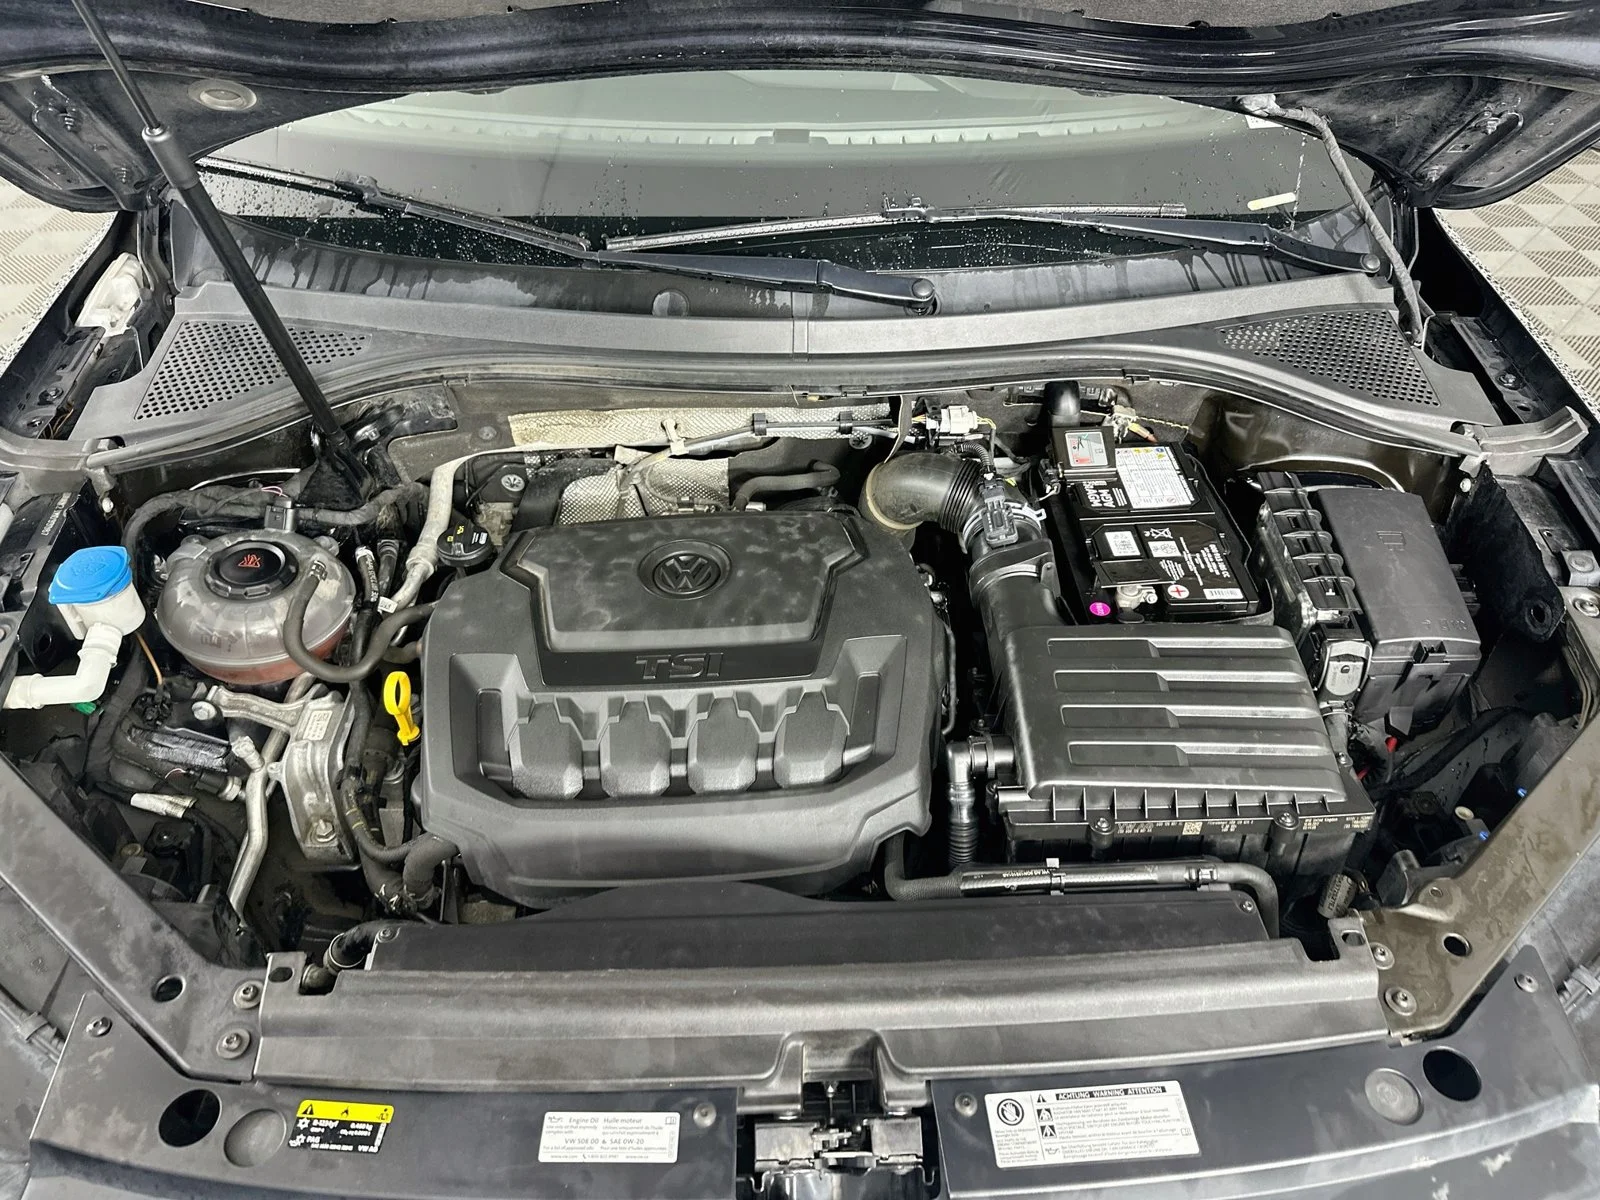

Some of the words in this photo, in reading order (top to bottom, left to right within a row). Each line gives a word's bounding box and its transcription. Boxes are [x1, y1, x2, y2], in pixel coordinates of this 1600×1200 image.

[1098, 489, 1116, 508] AGM
[635, 653, 724, 680] TSI
[1059, 1092, 1091, 1100] ACHTUNG
[1093, 1089, 1125, 1098] WARNING
[1127, 1086, 1162, 1095] ATTENTION
[569, 1117, 589, 1125] Engine
